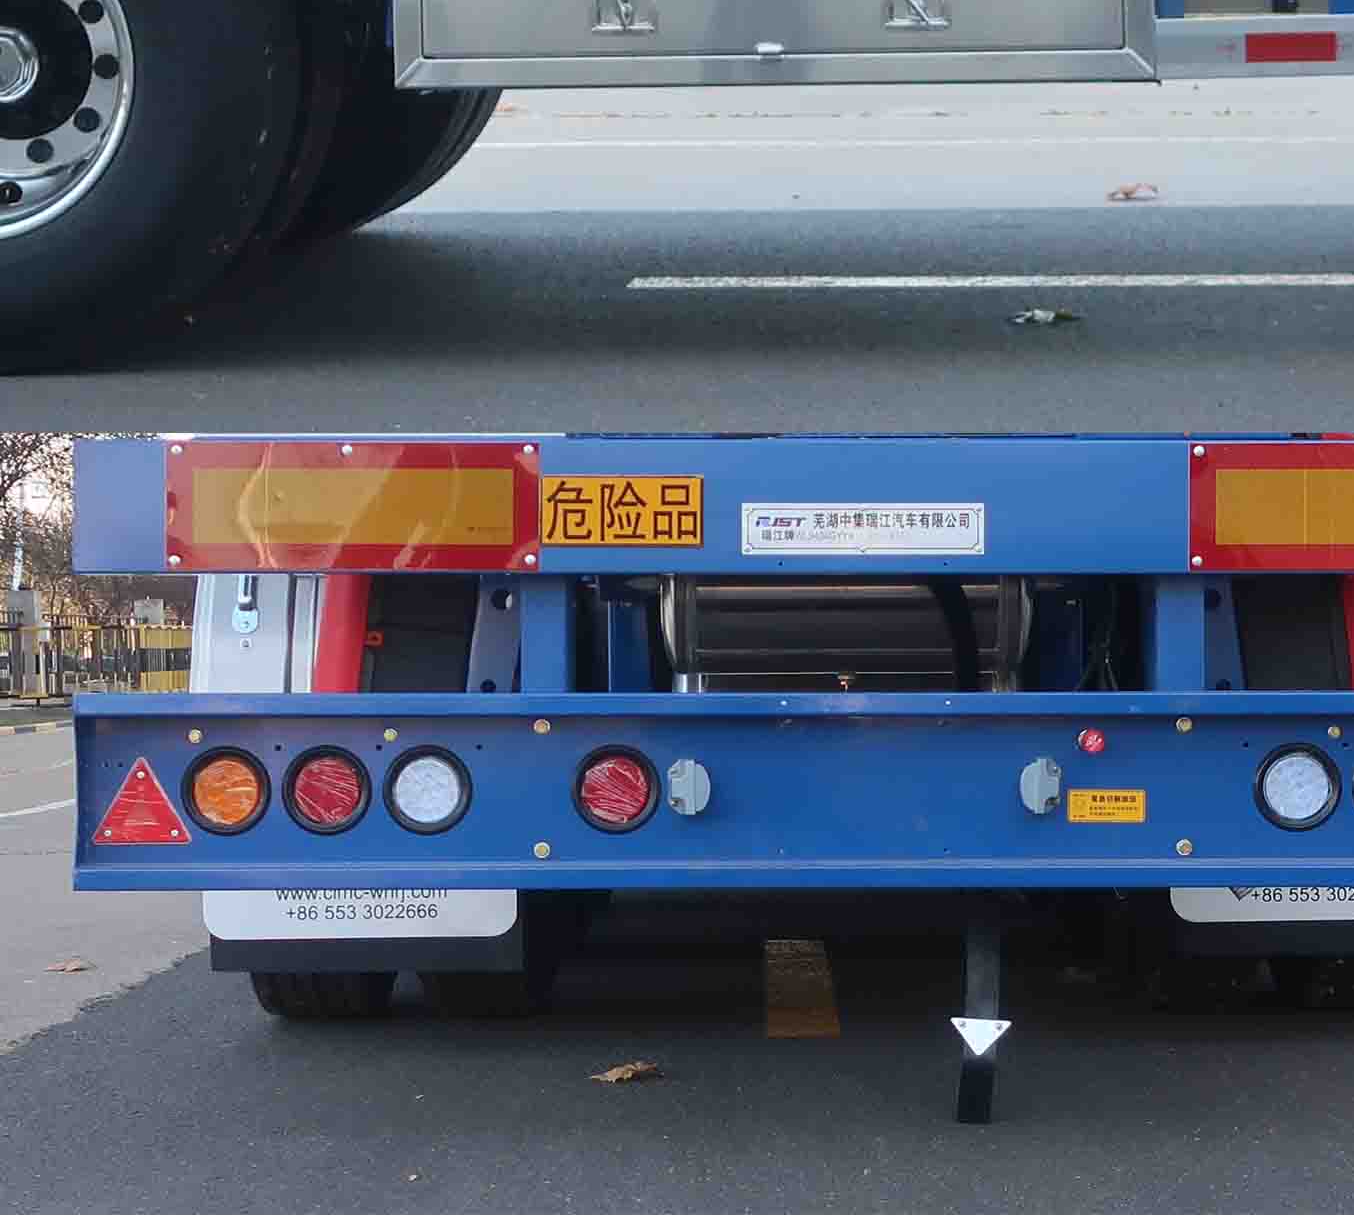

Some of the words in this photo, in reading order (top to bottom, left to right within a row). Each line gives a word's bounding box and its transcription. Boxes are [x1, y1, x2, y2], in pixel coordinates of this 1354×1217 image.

[546, 480, 698, 541] 危险品
[813, 512, 971, 530] 芜湖中集瑞江汽车有限公司
[1250, 887, 1283, 902] +86
[1288, 887, 1321, 902] 553
[286, 905, 319, 920] +86
[324, 905, 358, 920] 553
[363, 903, 439, 920] 3022666
